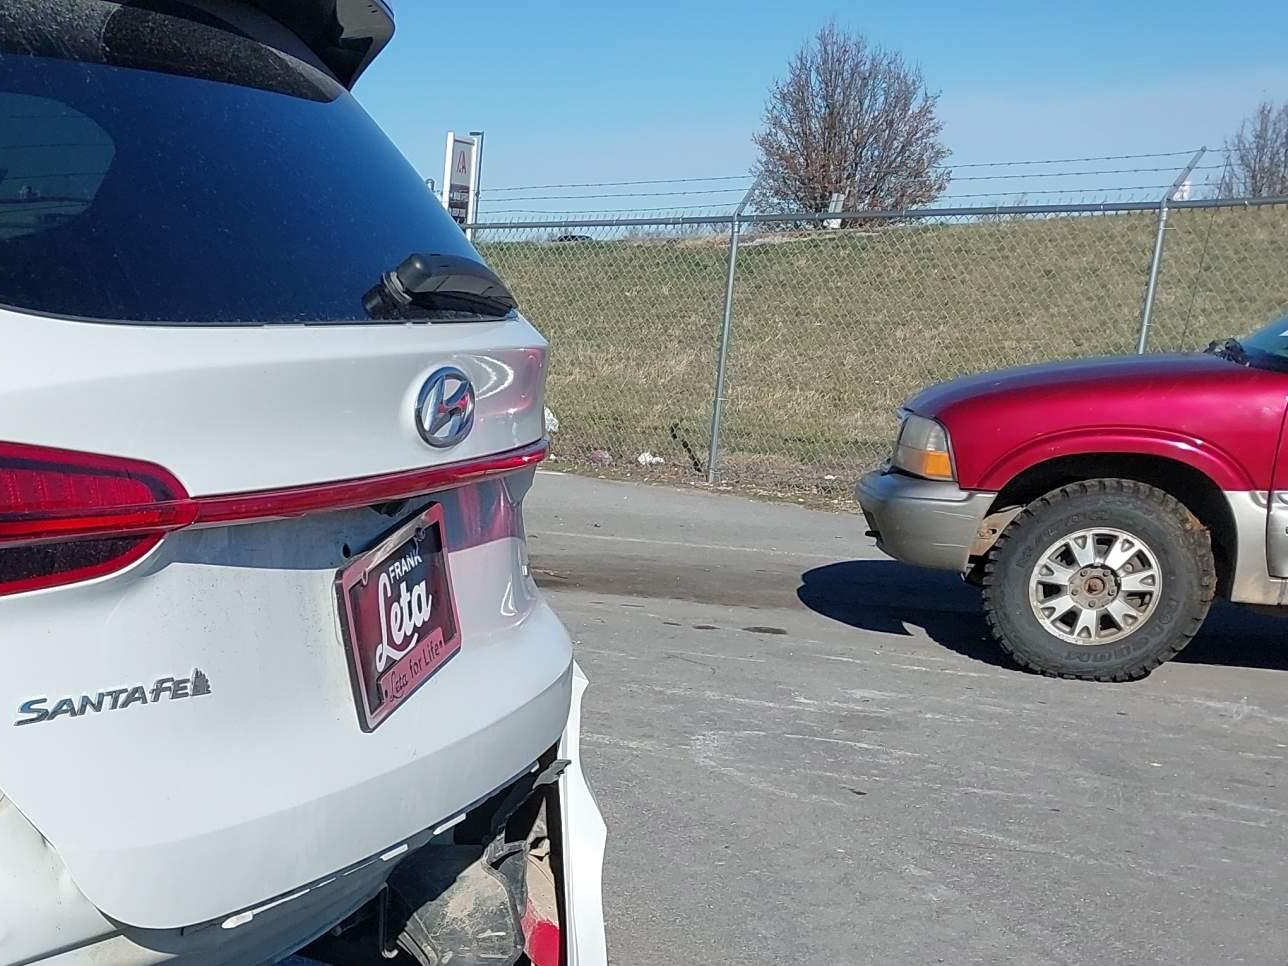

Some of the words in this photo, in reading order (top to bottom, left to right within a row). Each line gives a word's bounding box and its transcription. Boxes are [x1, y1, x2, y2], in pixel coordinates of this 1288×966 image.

[388, 550, 423, 584] FRANK
[375, 572, 432, 673] Leta
[390, 670, 409, 703] Leta
[409, 658, 424, 679] for
[422, 640, 441, 667] Life
